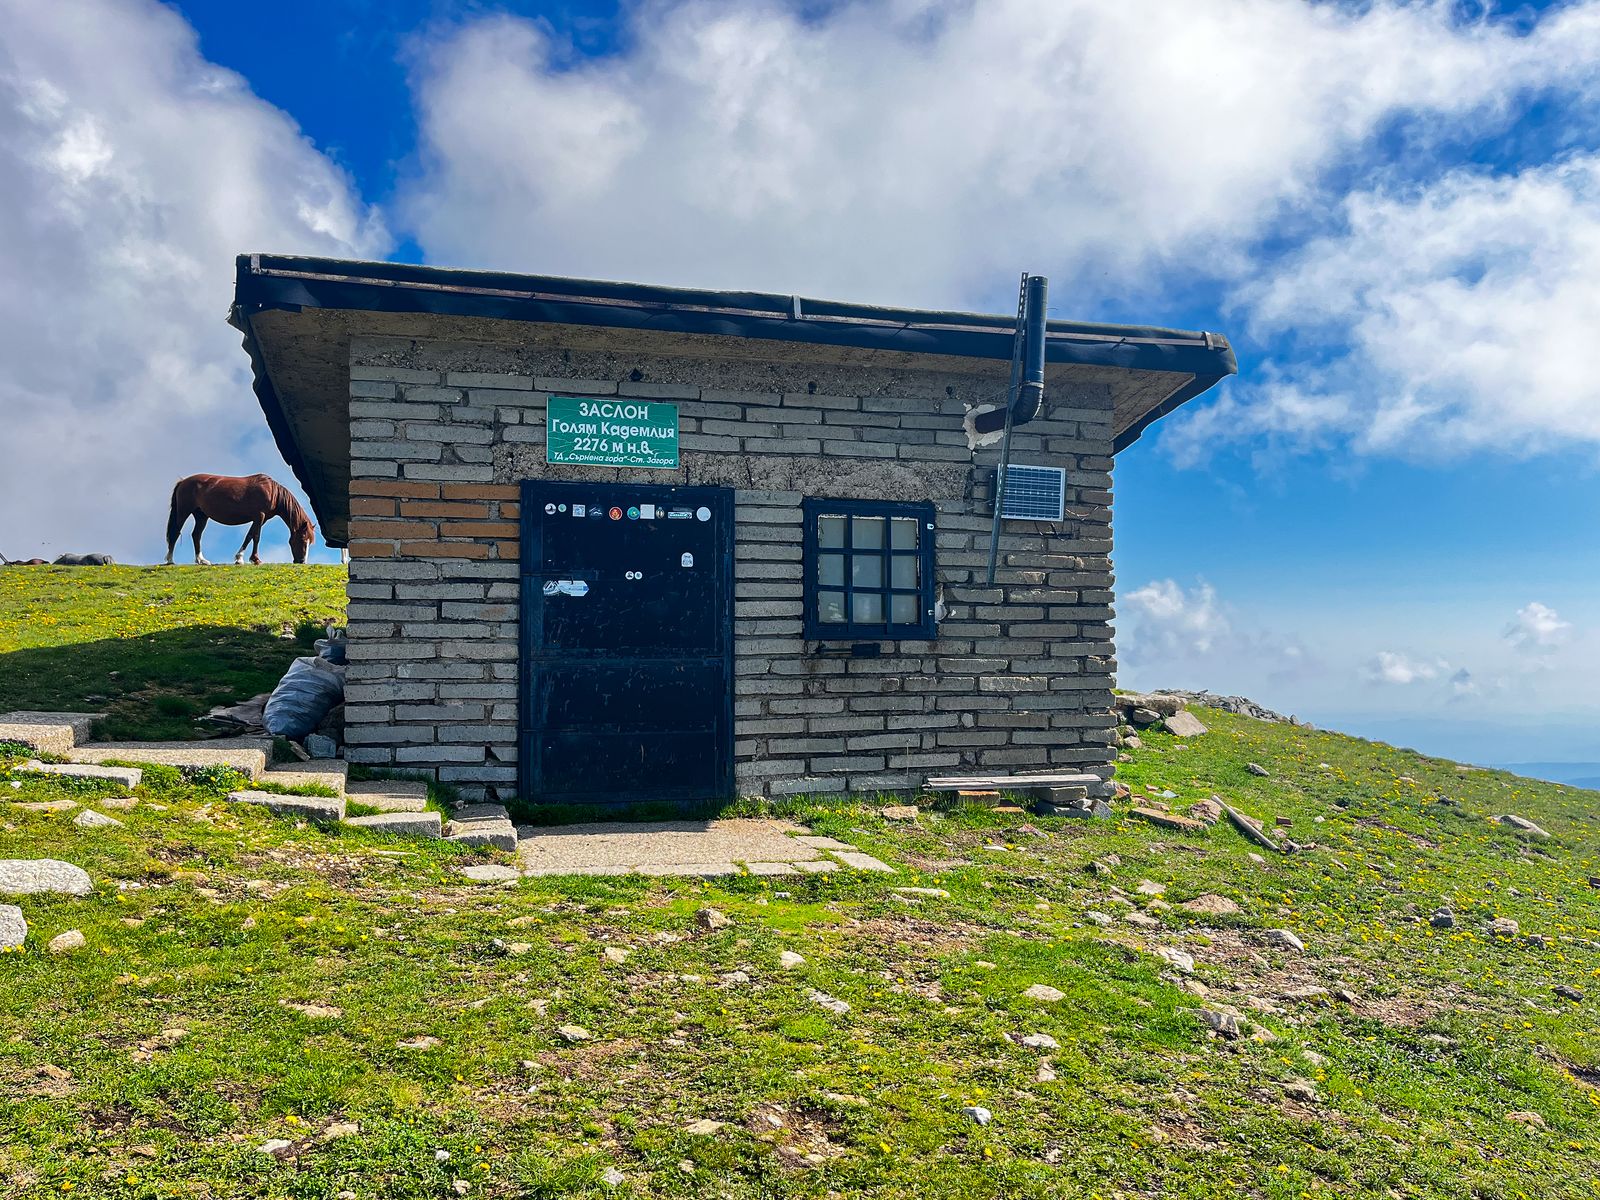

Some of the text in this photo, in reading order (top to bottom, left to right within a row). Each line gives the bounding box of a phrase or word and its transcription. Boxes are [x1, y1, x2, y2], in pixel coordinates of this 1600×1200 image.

[579, 402, 649, 420] ЗАСЛОН
[552, 419, 675, 440] Голям Кадемлия
[573, 437, 608, 452] 2276
[612, 443, 623, 454] м
[554, 452, 564, 461] ТД
[646, 457, 674, 465] Загора
